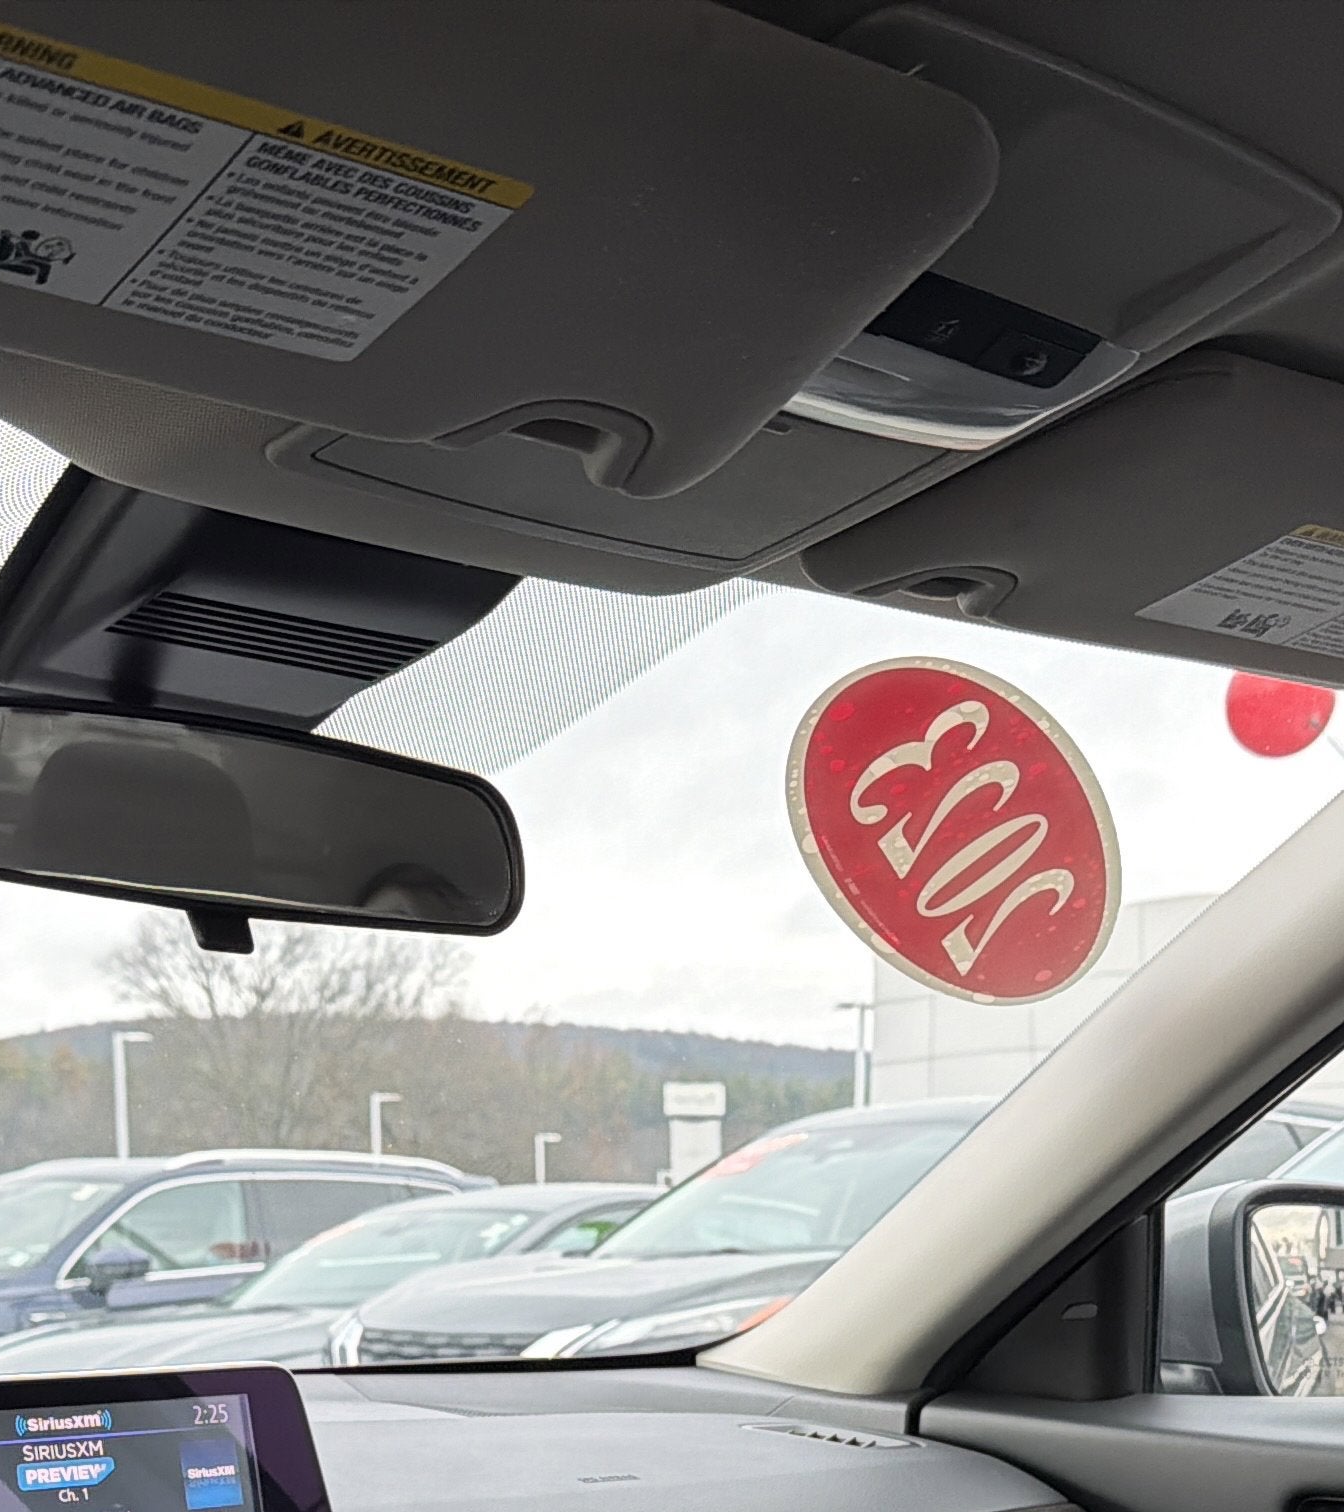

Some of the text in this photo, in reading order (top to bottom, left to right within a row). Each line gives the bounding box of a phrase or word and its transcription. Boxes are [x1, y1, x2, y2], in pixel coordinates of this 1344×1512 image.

[108, 98, 147, 118] AIR
[145, 108, 204, 135] BAGS
[242, 155, 356, 195] GONFLABLES
[311, 129, 497, 194] AVERTISSEMENT
[308, 157, 361, 179] AVEC
[355, 171, 395, 190] DES
[391, 181, 477, 213] COUSSINS
[193, 1403, 229, 1425] 2:25
[22, 1440, 105, 1461] SIRIUSXM
[25, 1463, 107, 1485] PREVIEW
[58, 1487, 89, 1502] Ch. 1
